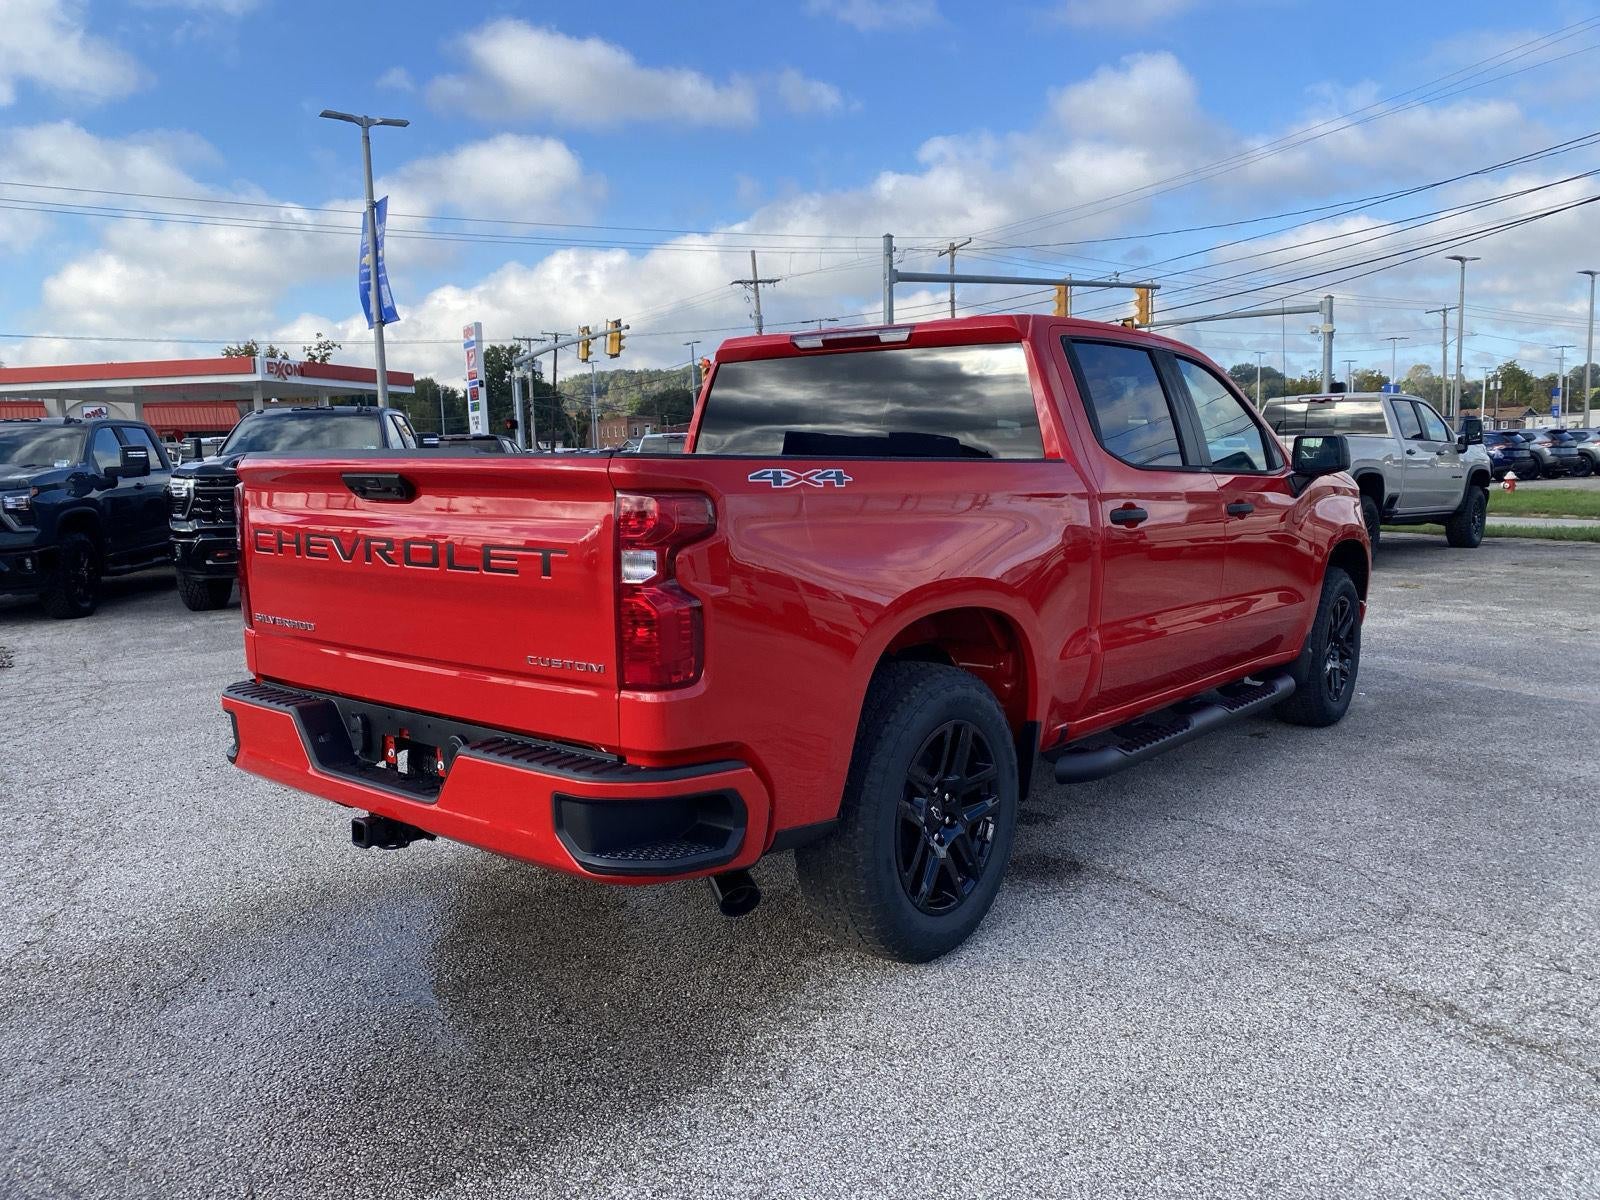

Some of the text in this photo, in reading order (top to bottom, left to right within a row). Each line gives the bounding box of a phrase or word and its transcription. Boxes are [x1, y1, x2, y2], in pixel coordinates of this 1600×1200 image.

[266, 361, 304, 380] EXXON
[254, 529, 568, 579] CHEVROLET
[255, 612, 316, 631] SILVERADO
[527, 655, 605, 673] CUSTOM
